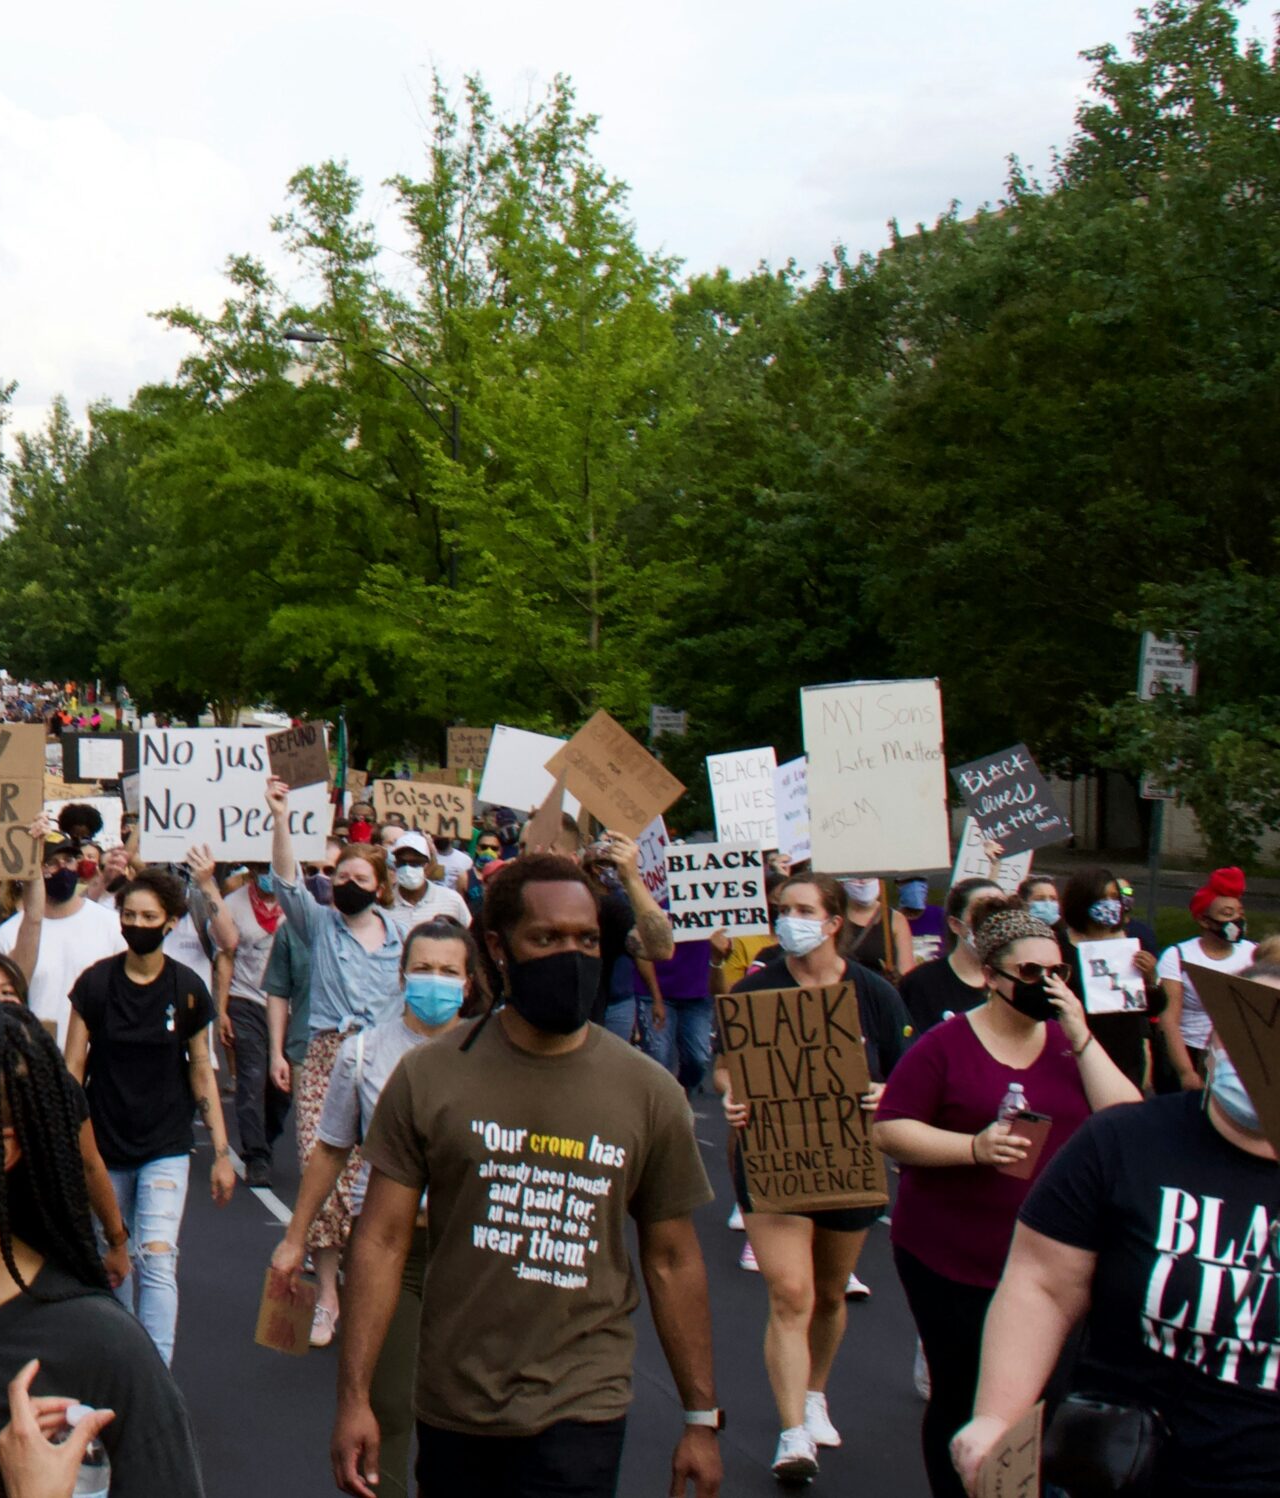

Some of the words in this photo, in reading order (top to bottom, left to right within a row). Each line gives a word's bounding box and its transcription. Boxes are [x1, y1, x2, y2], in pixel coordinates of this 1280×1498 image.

[822, 696, 864, 736] MY
[875, 693, 936, 732] Sons
[143, 732, 193, 766] No
[709, 755, 769, 785] BLACK
[959, 753, 1030, 795] BLACK
[143, 788, 196, 833] No
[720, 788, 776, 813] LIVES
[720, 818, 776, 844] MATTE
[667, 850, 762, 873] BLACK
[671, 880, 758, 902] LIVES
[668, 907, 769, 930] MATTER
[718, 986, 857, 1051] BLACK
[740, 1045, 845, 1099] LIVES
[740, 1092, 872, 1151] MATTER!
[471, 1120, 528, 1154] "Our
[529, 1133, 585, 1160] crown
[588, 1134, 626, 1168] has
[747, 1149, 837, 1174] SILENCE
[849, 1147, 875, 1167] IS
[479, 1159, 531, 1184] already
[532, 1166, 565, 1187] been
[567, 1171, 612, 1196] bought
[752, 1168, 878, 1197] VIOLENCE
[489, 1182, 521, 1206] and
[523, 1186, 564, 1213] paid
[566, 1193, 597, 1222] for.
[488, 1205, 503, 1223] All
[504, 1210, 519, 1225] we
[521, 1211, 548, 1229] have
[549, 1215, 562, 1232] to
[563, 1219, 578, 1235] do
[579, 1221, 590, 1238] is
[1156, 1186, 1280, 1274] BLA
[473, 1225, 523, 1256] wear
[1140, 1251, 1280, 1341] LIV
[1141, 1317, 1280, 1391] MATT
